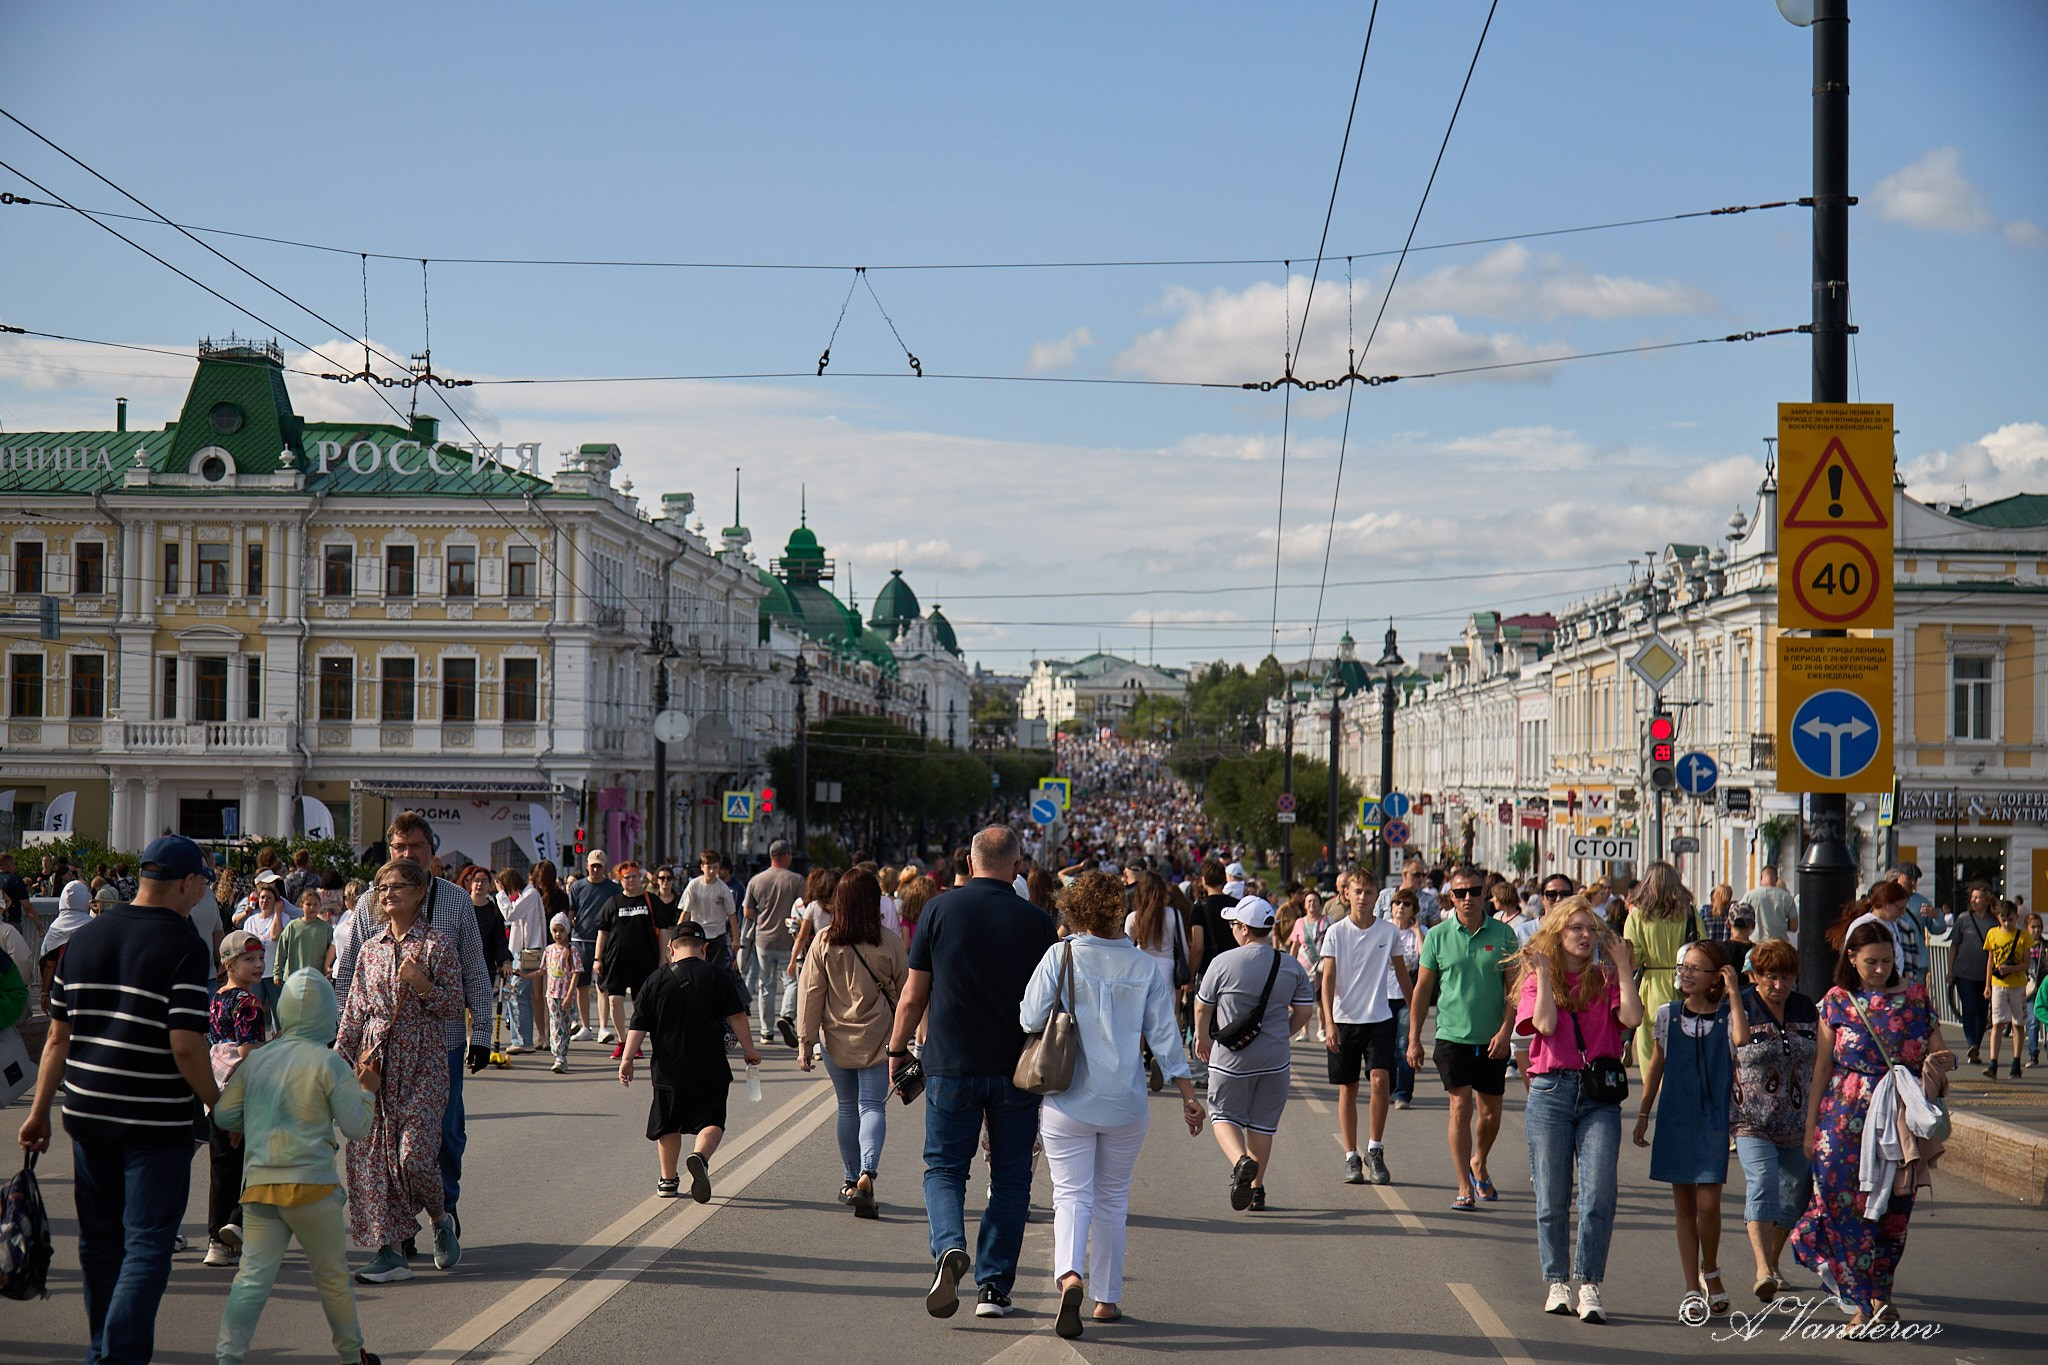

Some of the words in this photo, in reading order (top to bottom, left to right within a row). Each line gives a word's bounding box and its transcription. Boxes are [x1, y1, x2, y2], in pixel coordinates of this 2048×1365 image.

[316, 440, 542, 475] РОССИЯ
[1811, 562, 1860, 596] 40
[1785, 646, 1825, 654] ЗАКРЫТИЕ
[1826, 646, 1854, 655] УЛИЦЫ
[1855, 646, 1885, 654] ЛЕНИНА
[1790, 655, 1821, 663] ПЕРИОД
[1849, 655, 1887, 663] ПЯТНИЦЫ
[1999, 791, 2048, 806] COFFEE
[1574, 839, 1633, 858] СТОП
